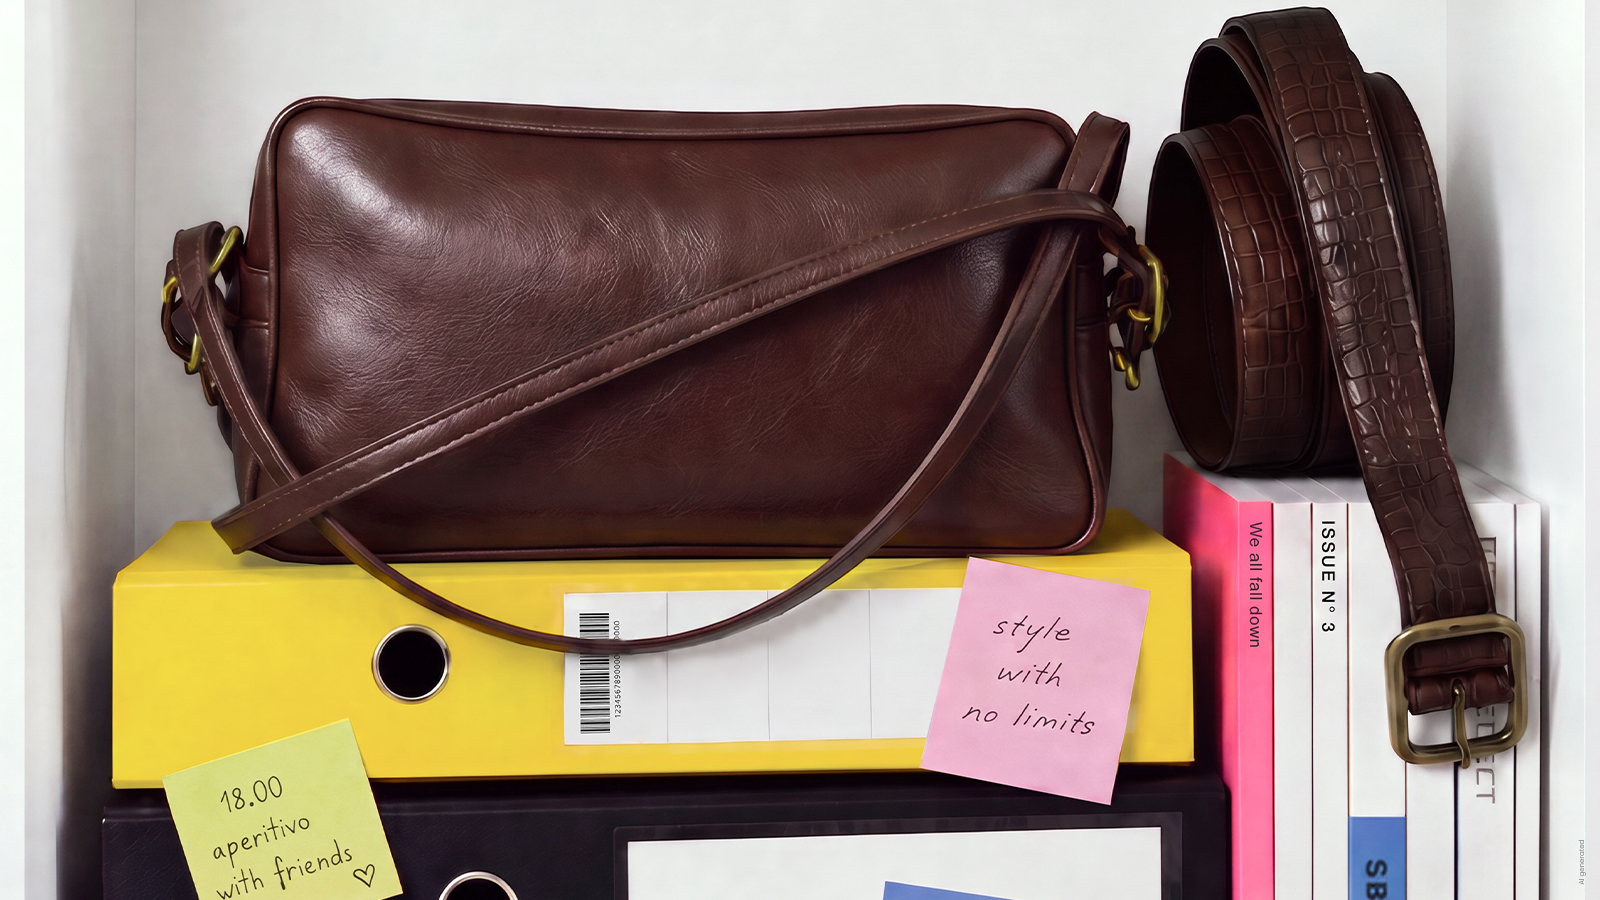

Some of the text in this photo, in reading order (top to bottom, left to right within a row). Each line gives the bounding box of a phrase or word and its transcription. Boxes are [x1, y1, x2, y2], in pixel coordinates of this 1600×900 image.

[1321, 520, 1336, 582] ISSUE
[1249, 521, 1263, 648] We all fall down
[992, 614, 1071, 654] style
[1321, 622, 1336, 633] 3
[997, 661, 1063, 687] with
[961, 703, 1096, 735] no limits
[220, 775, 283, 813] 18.00
[212, 816, 311, 869] aperitivo
[216, 838, 353, 900] with friends
